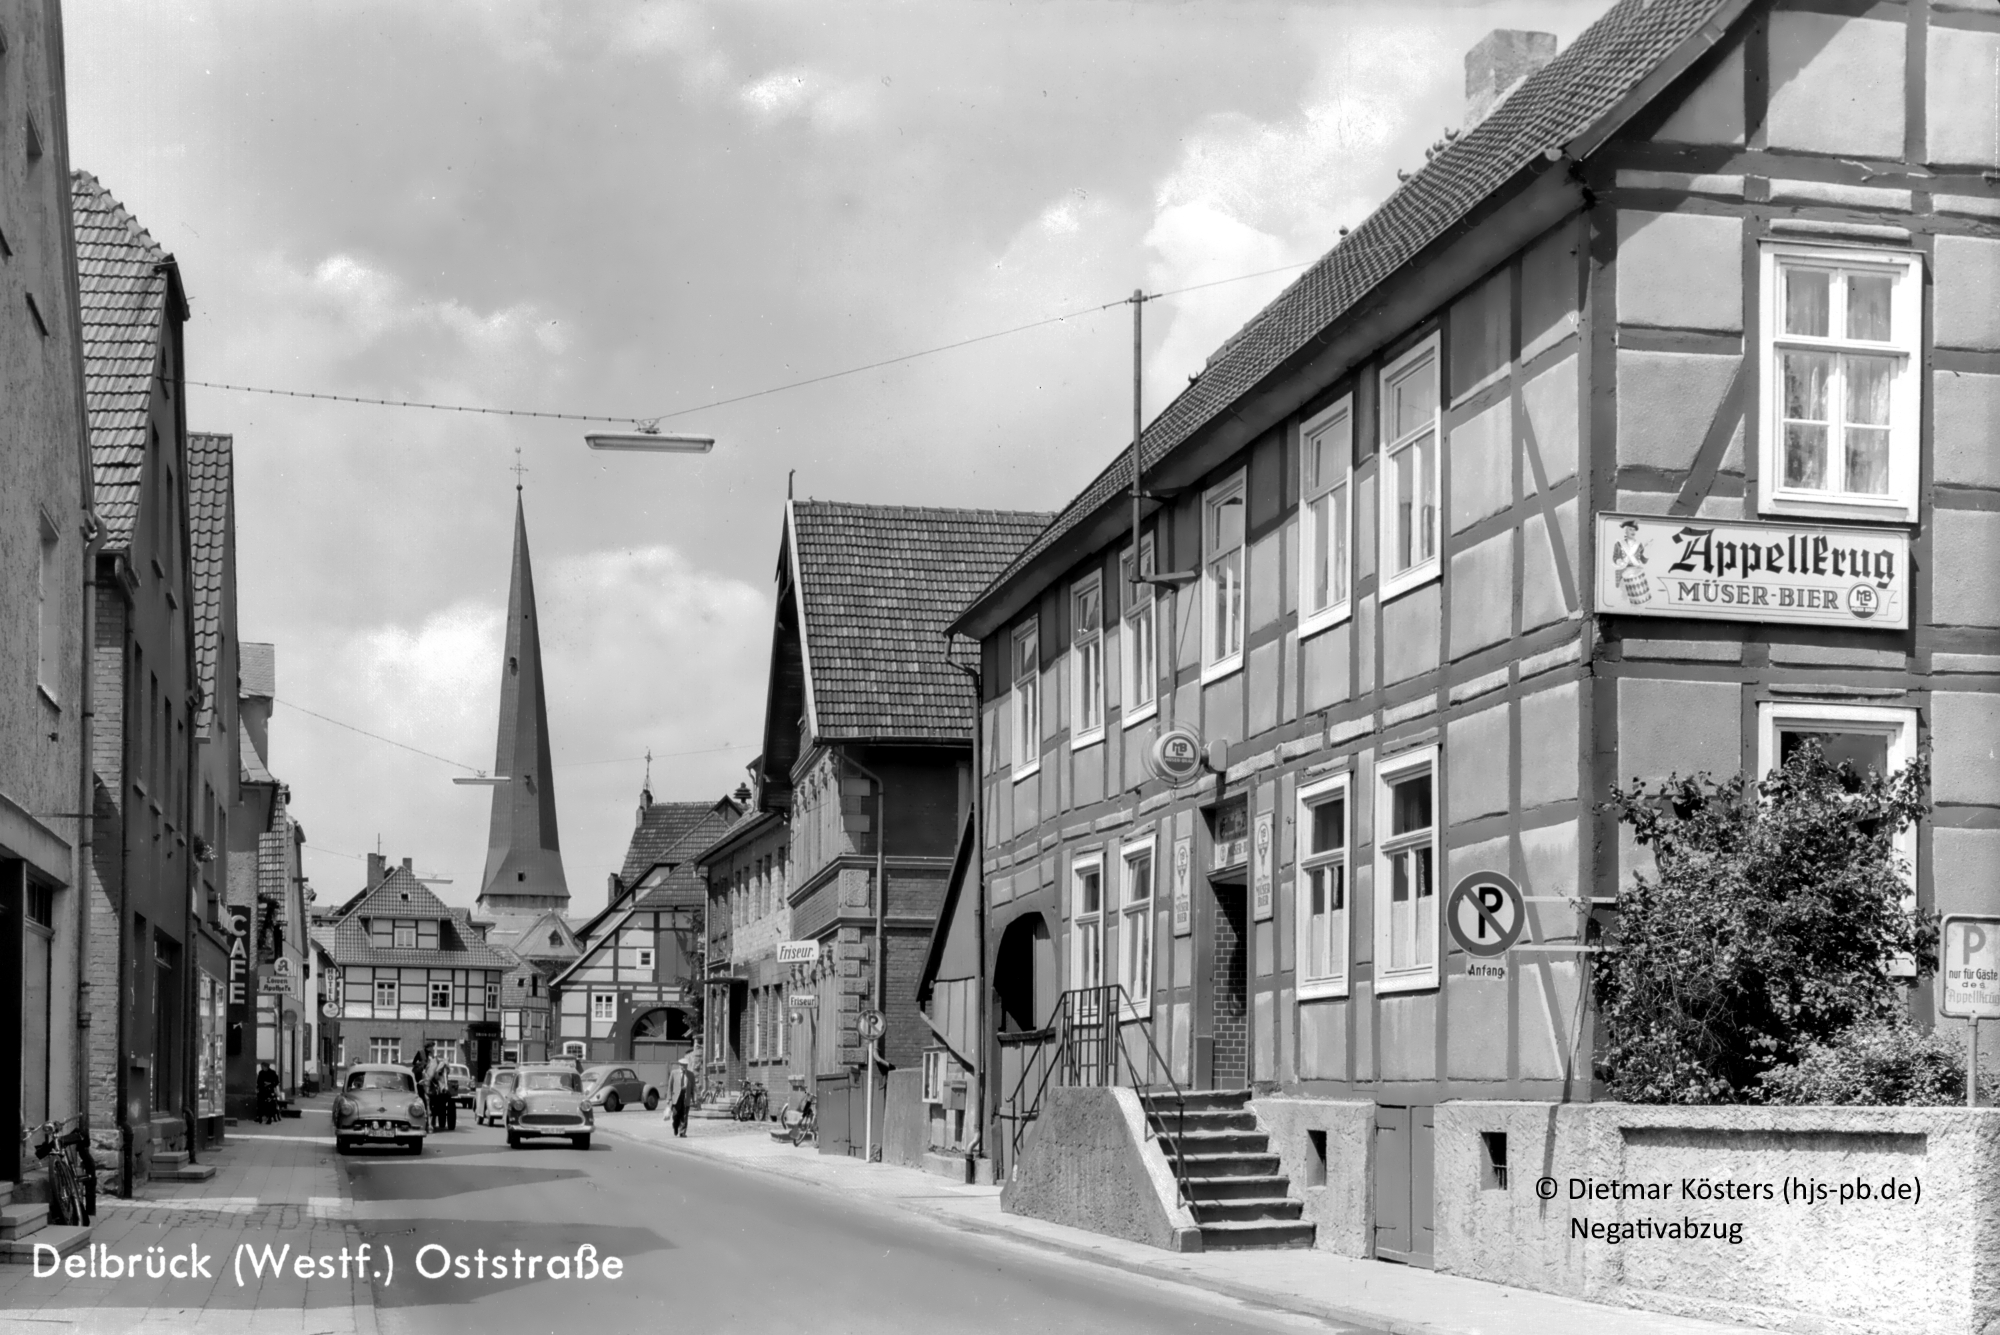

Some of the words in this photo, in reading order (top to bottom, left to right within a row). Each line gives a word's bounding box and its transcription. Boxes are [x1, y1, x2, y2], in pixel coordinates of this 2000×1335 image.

[1668, 526, 1895, 589] Appellkrug
[1677, 579, 1839, 610] MÜSER-BIER
[1478, 886, 1504, 939] P
[229, 914, 247, 1004] CAFE
[1963, 924, 1986, 965] P
[1469, 964, 1505, 979] Anfang
[1948, 970, 1962, 979] nur
[1963, 967, 1975, 979] für
[1975, 968, 1998, 981] Gäste
[790, 996, 815, 1006] Friseur
